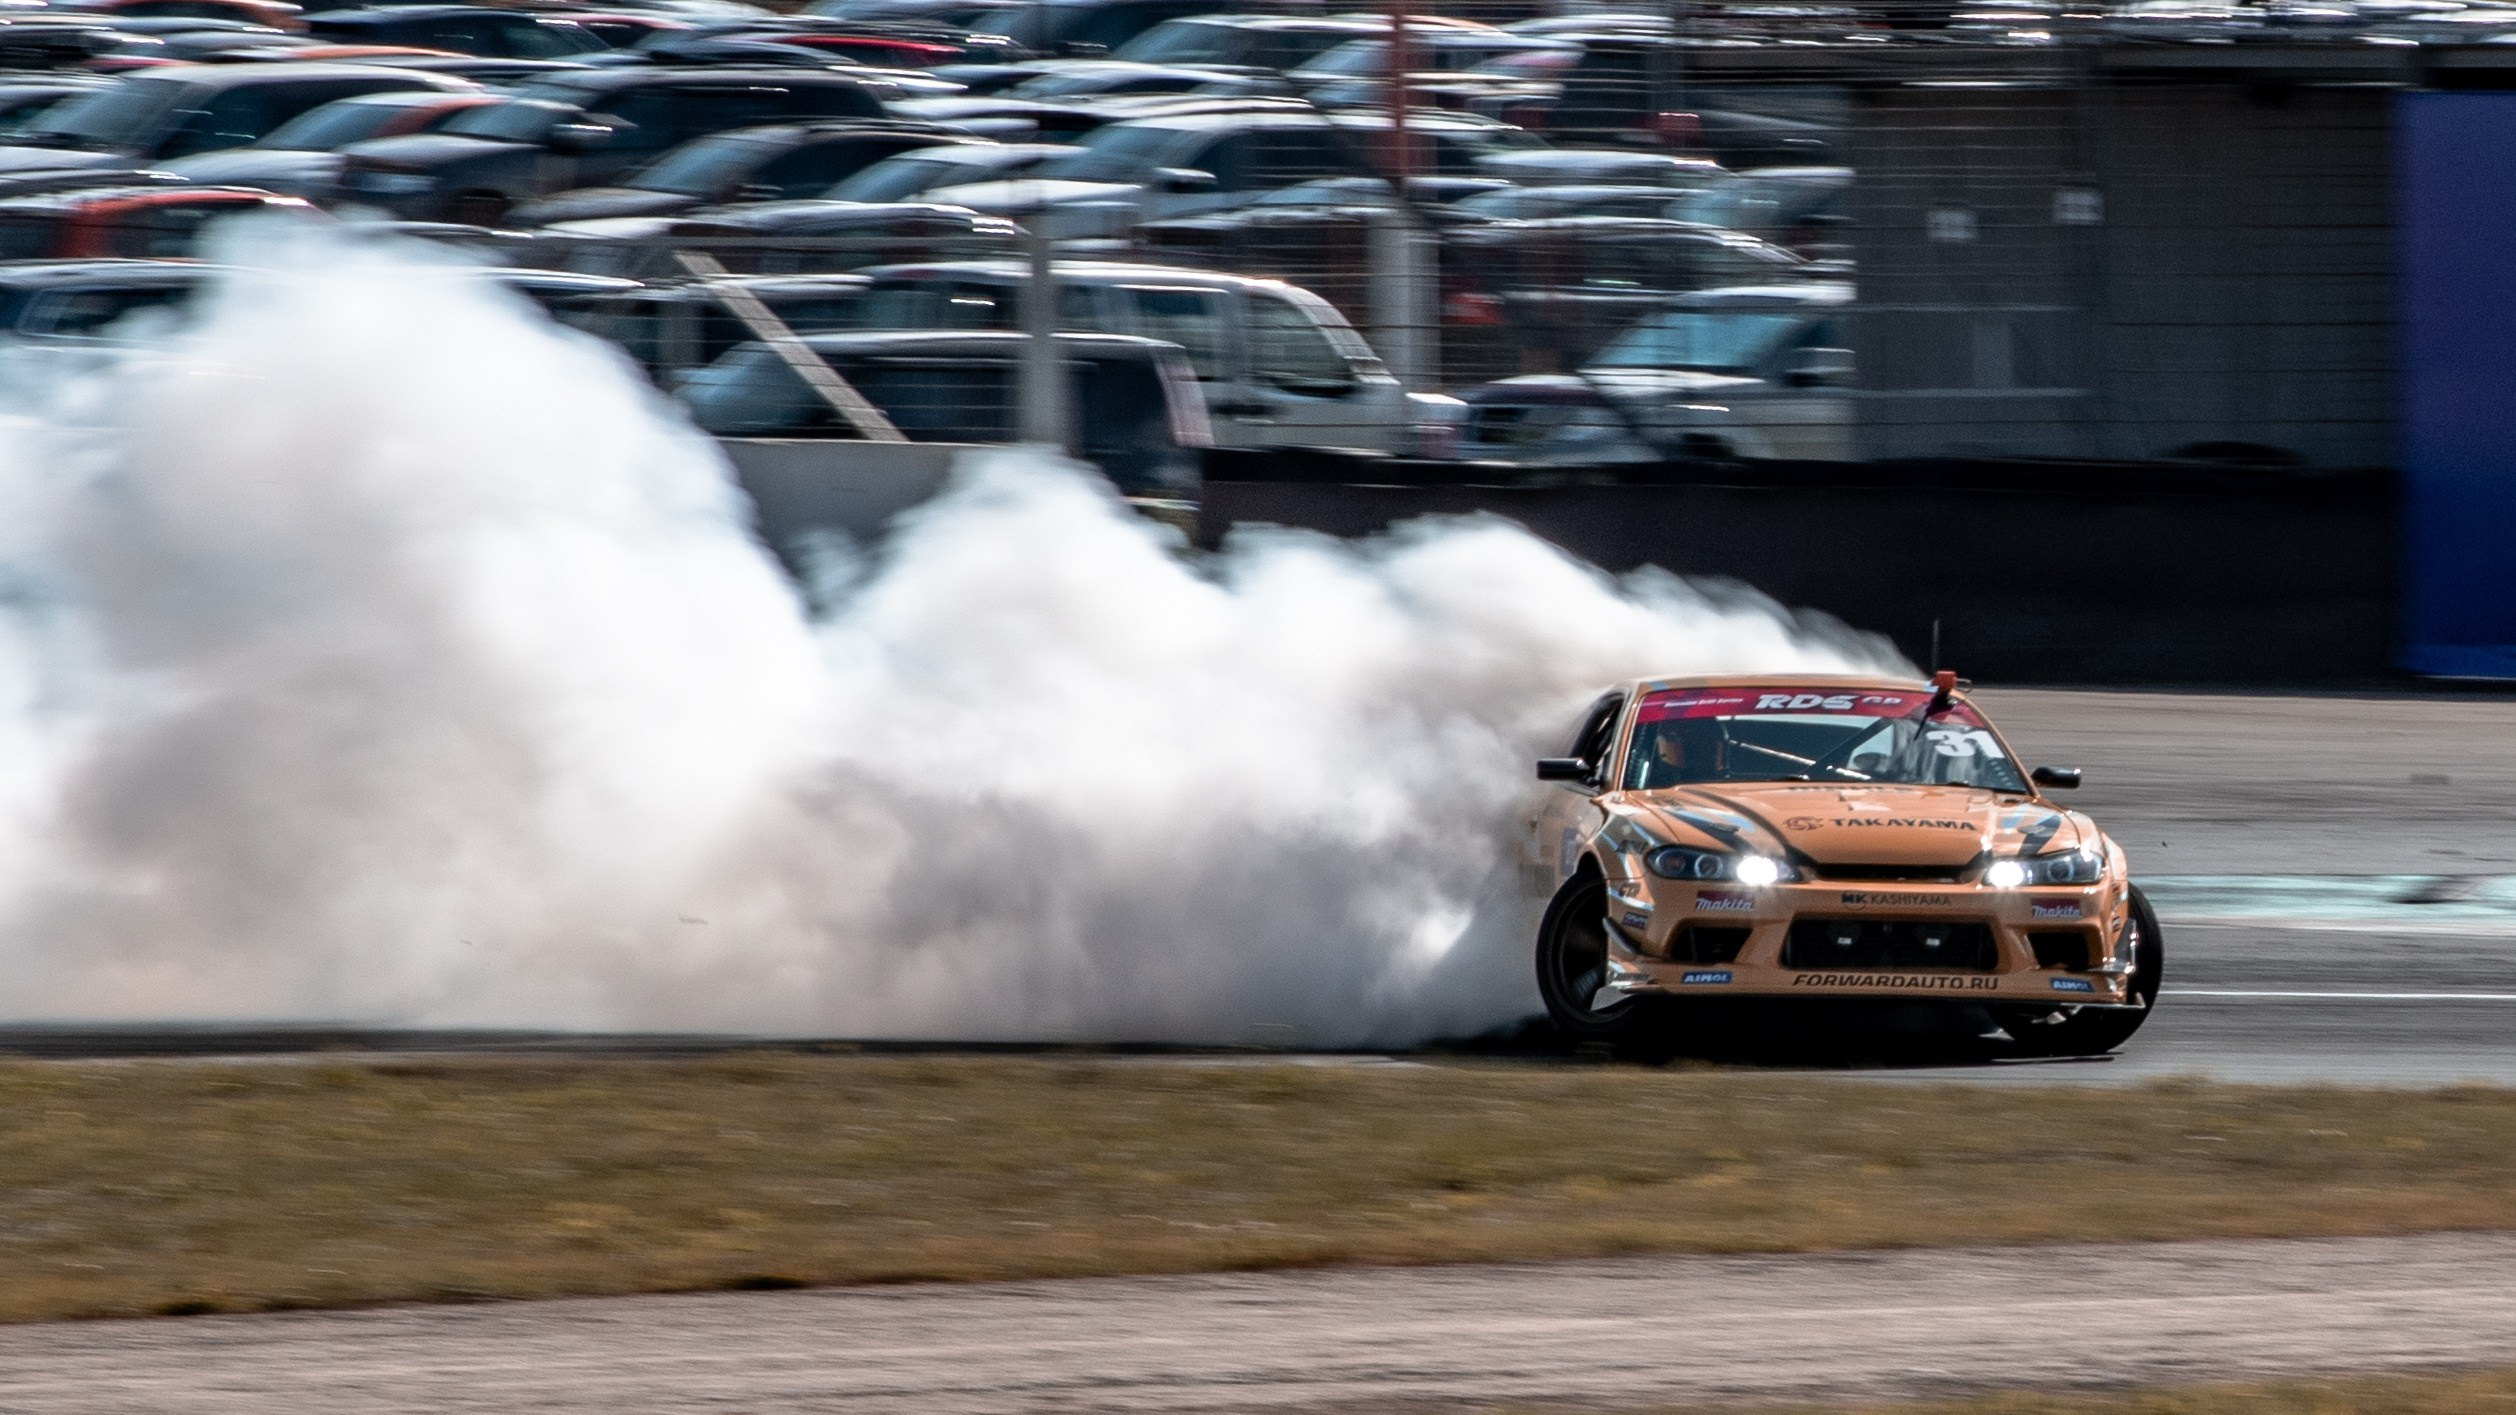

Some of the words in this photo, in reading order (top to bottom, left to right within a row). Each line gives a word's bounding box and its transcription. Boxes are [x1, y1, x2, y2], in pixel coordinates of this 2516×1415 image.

[1755, 694, 1860, 710] RDS
[1925, 730, 2006, 758] 31
[1829, 818, 1977, 831] TAKAYAMA
[1871, 894, 1952, 906] KASHIYAMA
[1684, 973, 1729, 983] AIMOL
[1792, 974, 1999, 990] FORWARDAUTO.RU
